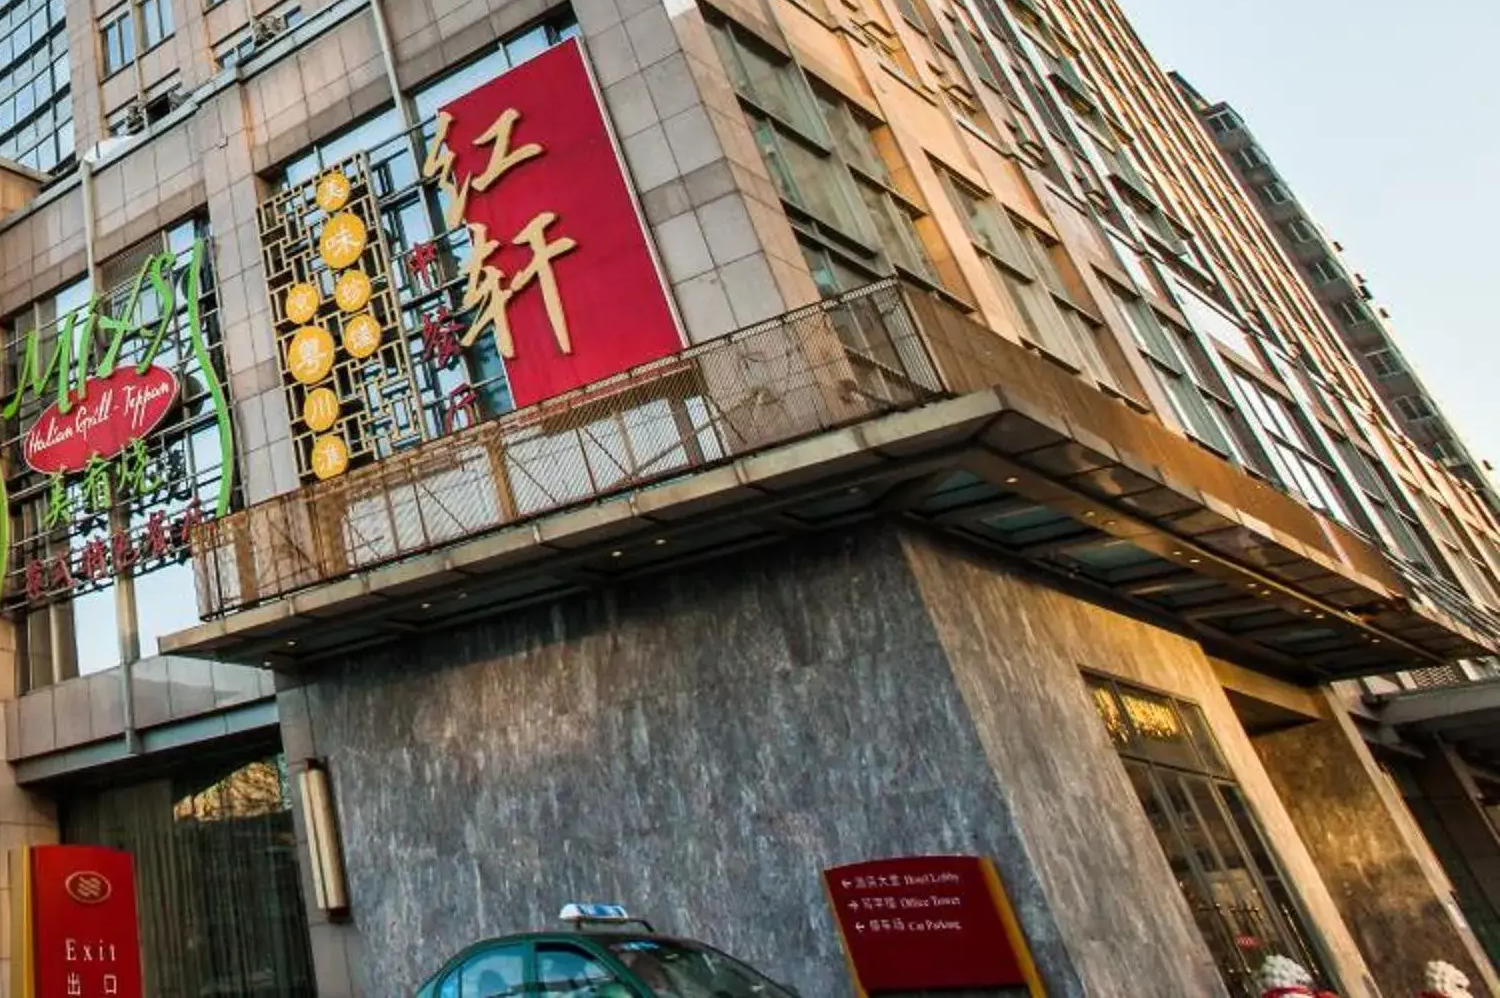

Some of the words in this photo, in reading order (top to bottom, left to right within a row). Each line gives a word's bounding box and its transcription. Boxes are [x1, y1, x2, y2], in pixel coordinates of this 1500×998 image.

[423, 108, 577, 359] 红轩
[29, 415, 74, 459] Italian
[75, 389, 114, 440] Grill
[65, 938, 117, 962] Exit
[67, 971, 118, 996] 出口
